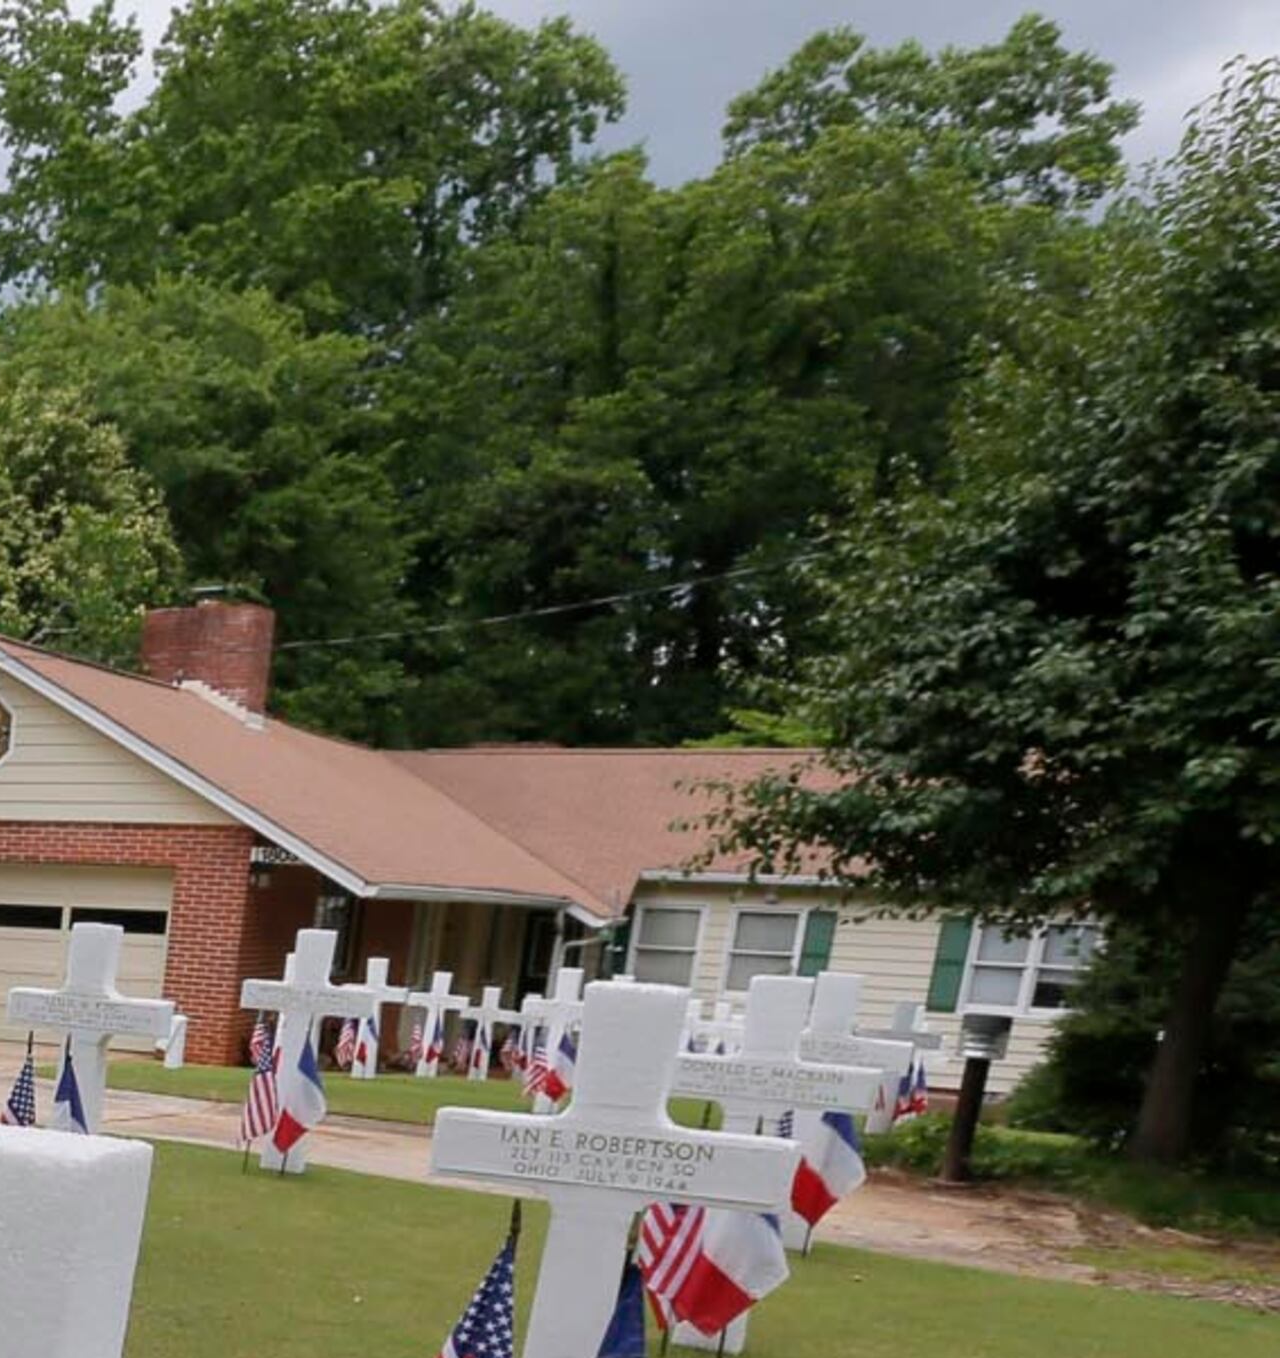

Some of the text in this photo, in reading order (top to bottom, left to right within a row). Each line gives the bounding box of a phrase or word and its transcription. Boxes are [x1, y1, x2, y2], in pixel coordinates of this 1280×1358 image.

[500, 1125, 541, 1145] IAN
[575, 1132, 715, 1162] ROBERTSON
[579, 1153, 616, 1169] CAV
[513, 1162, 561, 1177] OHIO
[578, 1168, 620, 1184] JULY
[646, 1175, 689, 1191] 1944
